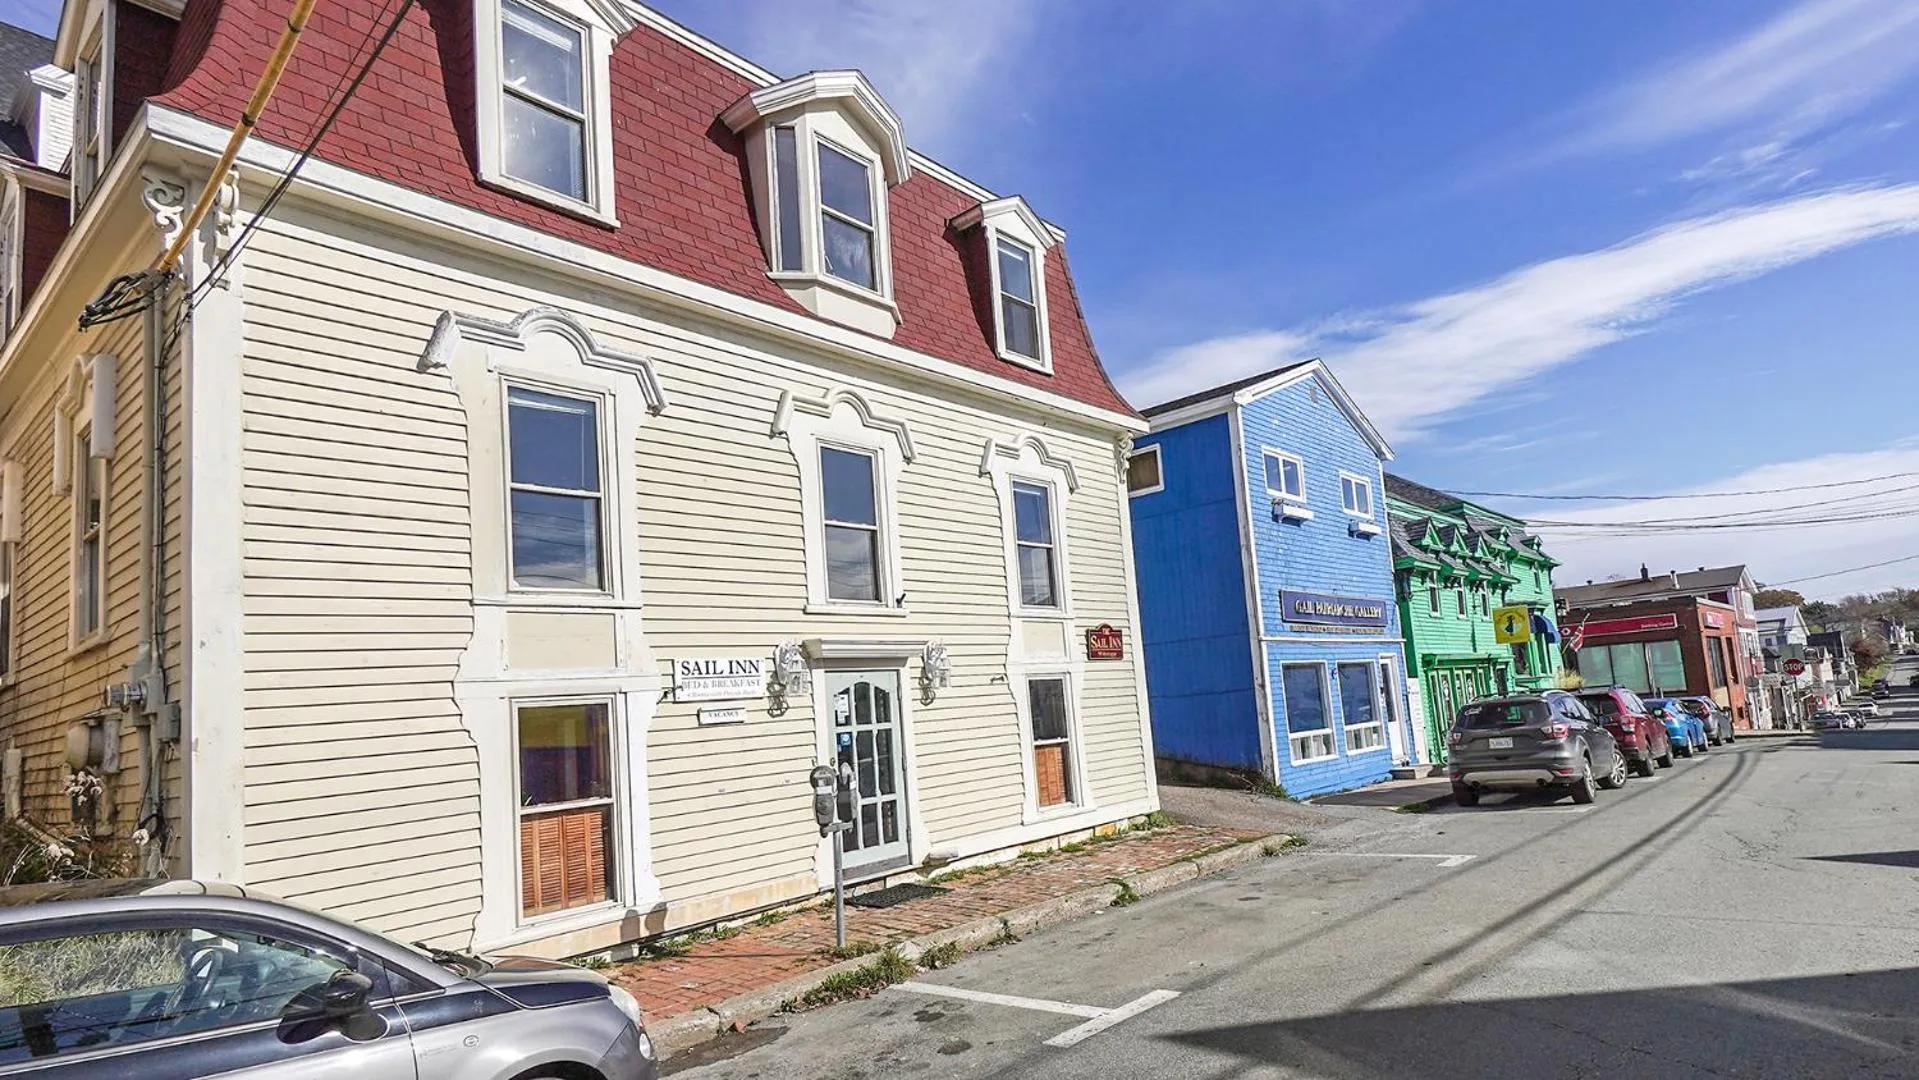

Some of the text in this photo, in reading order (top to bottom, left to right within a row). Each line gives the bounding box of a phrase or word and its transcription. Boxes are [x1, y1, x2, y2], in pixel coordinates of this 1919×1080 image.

[681, 659, 760, 676] SAIL INN
[1784, 663, 1803, 671] STOP
[682, 680, 701, 690] BED
[711, 679, 761, 689] BREAKFAST
